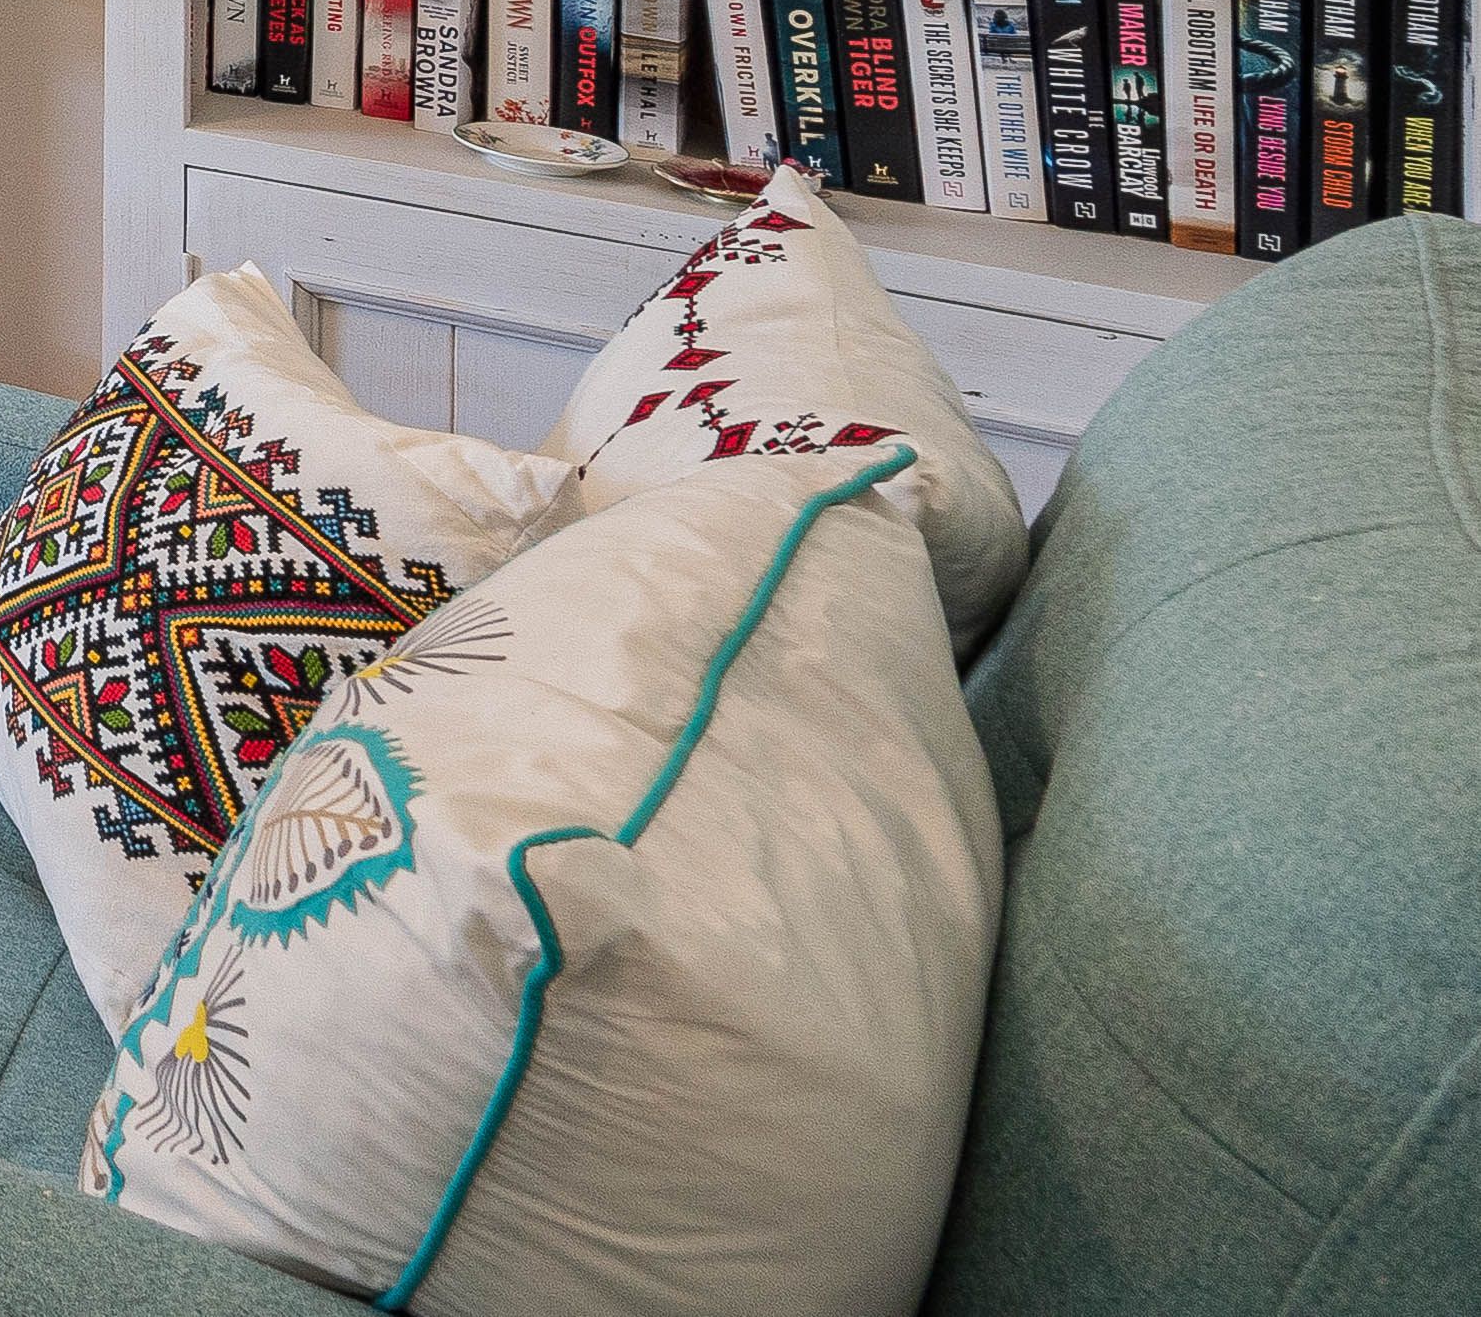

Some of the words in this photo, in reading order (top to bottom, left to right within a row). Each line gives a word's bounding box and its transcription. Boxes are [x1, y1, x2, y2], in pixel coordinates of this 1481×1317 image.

[575, 26, 598, 108] OUTFOX
[1117, 3, 1148, 68] MAKER
[1187, 8, 1218, 92] ROBOTHAM
[733, 45, 759, 119] FRICTION
[788, 9, 826, 146] OVERKILL
[847, 37, 876, 109] TIGER
[871, 38, 899, 111] BLIND
[1047, 47, 1087, 116] WHITE
[1053, 125, 1094, 190] CROW
[1116, 123, 1145, 200] BARCLAY
